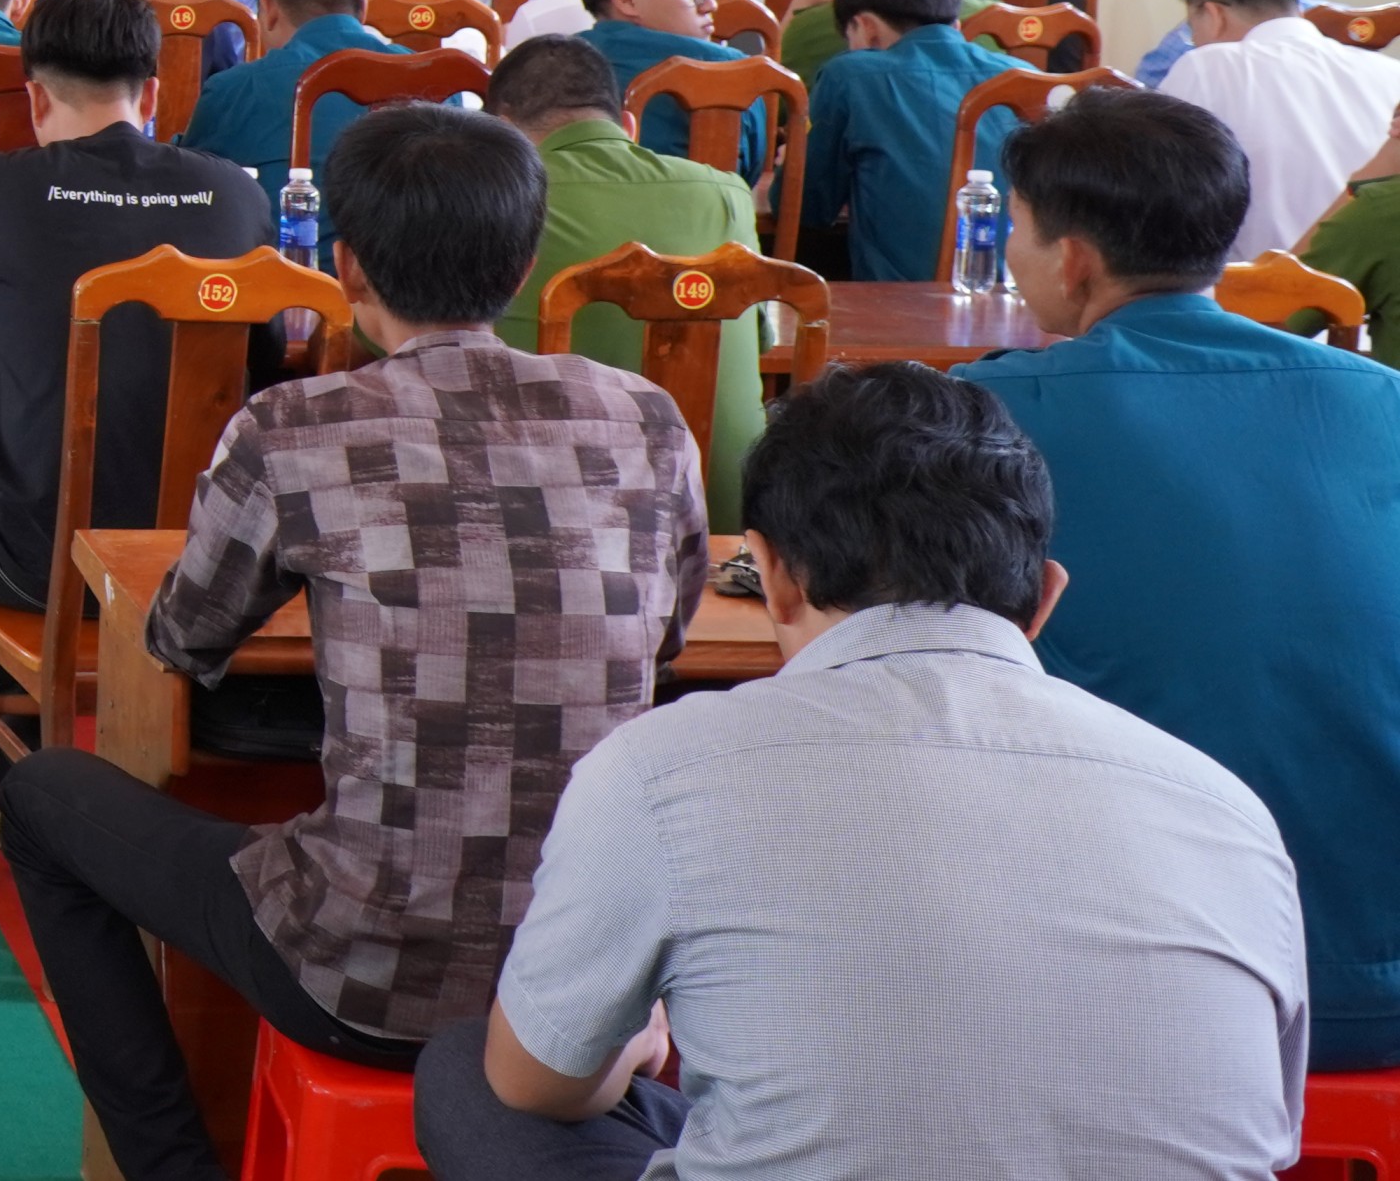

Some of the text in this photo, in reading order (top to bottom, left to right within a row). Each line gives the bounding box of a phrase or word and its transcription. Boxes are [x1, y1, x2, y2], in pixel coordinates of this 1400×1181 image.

[174, 11, 192, 24] 18
[411, 10, 431, 24] 26
[47, 184, 213, 208] /Everything is going well/
[200, 283, 235, 304] 152
[677, 278, 711, 302] 149
